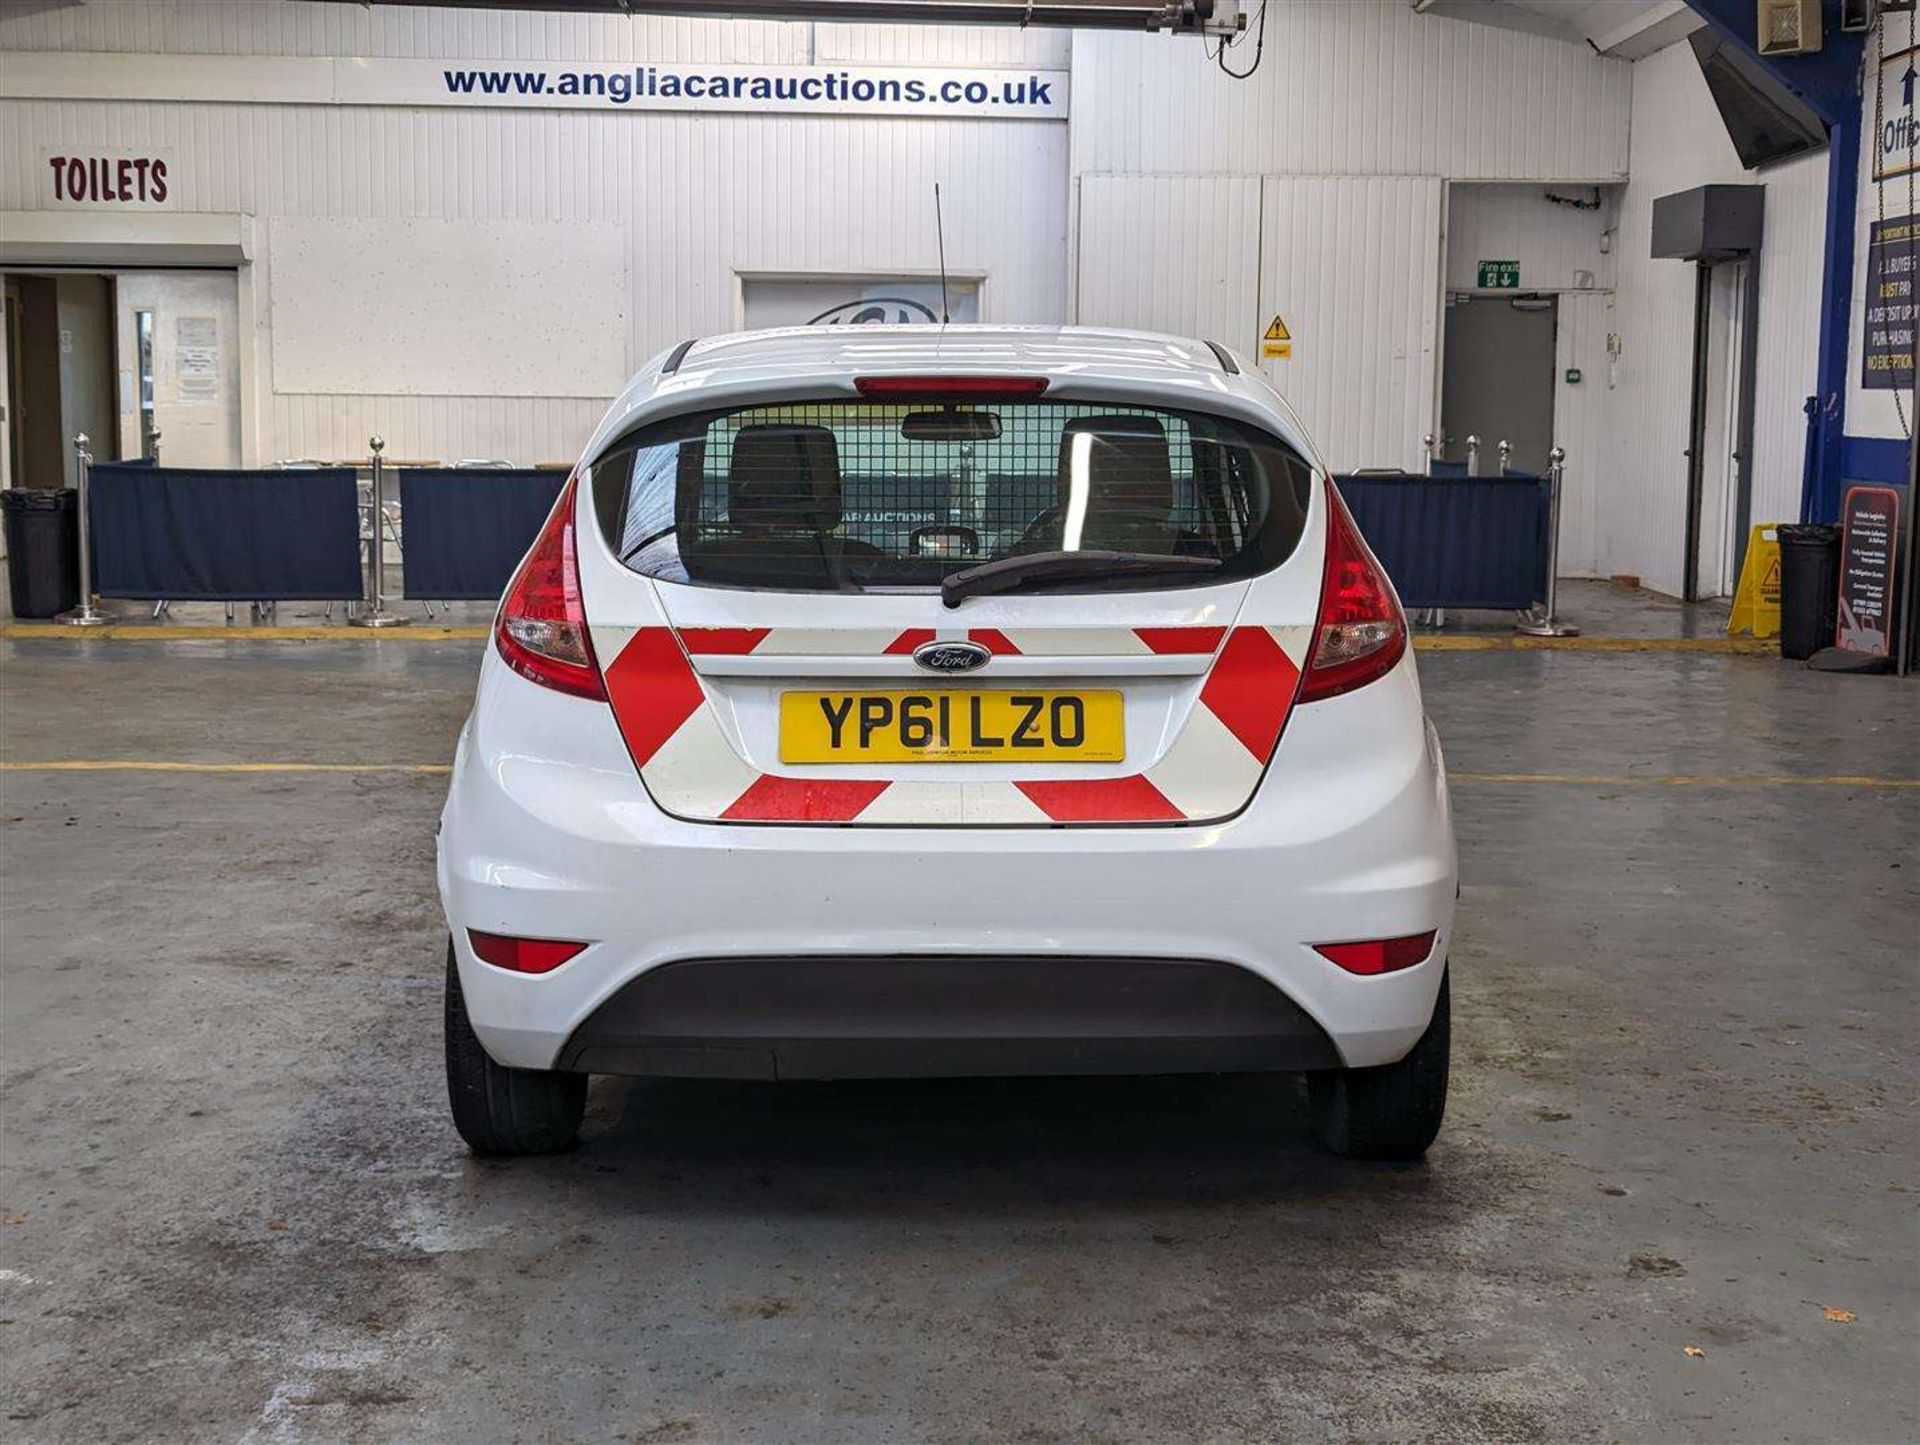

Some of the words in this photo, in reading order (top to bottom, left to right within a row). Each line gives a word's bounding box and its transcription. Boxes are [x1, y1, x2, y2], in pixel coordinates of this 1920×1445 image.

[444, 67, 1052, 105] www.angliacarauctions.co.uk
[50, 157, 167, 202] TOILETS
[1480, 262, 1499, 271] Fire
[1501, 262, 1519, 272] exit
[1878, 258, 1890, 274] AL
[1902, 303, 1919, 320] UPN
[1872, 329, 1914, 347] PURHASIN
[866, 512, 936, 522] AUCTIONS
[931, 649, 973, 667] Ford
[820, 696, 950, 748] YP61
[971, 696, 1084, 748] LZO
